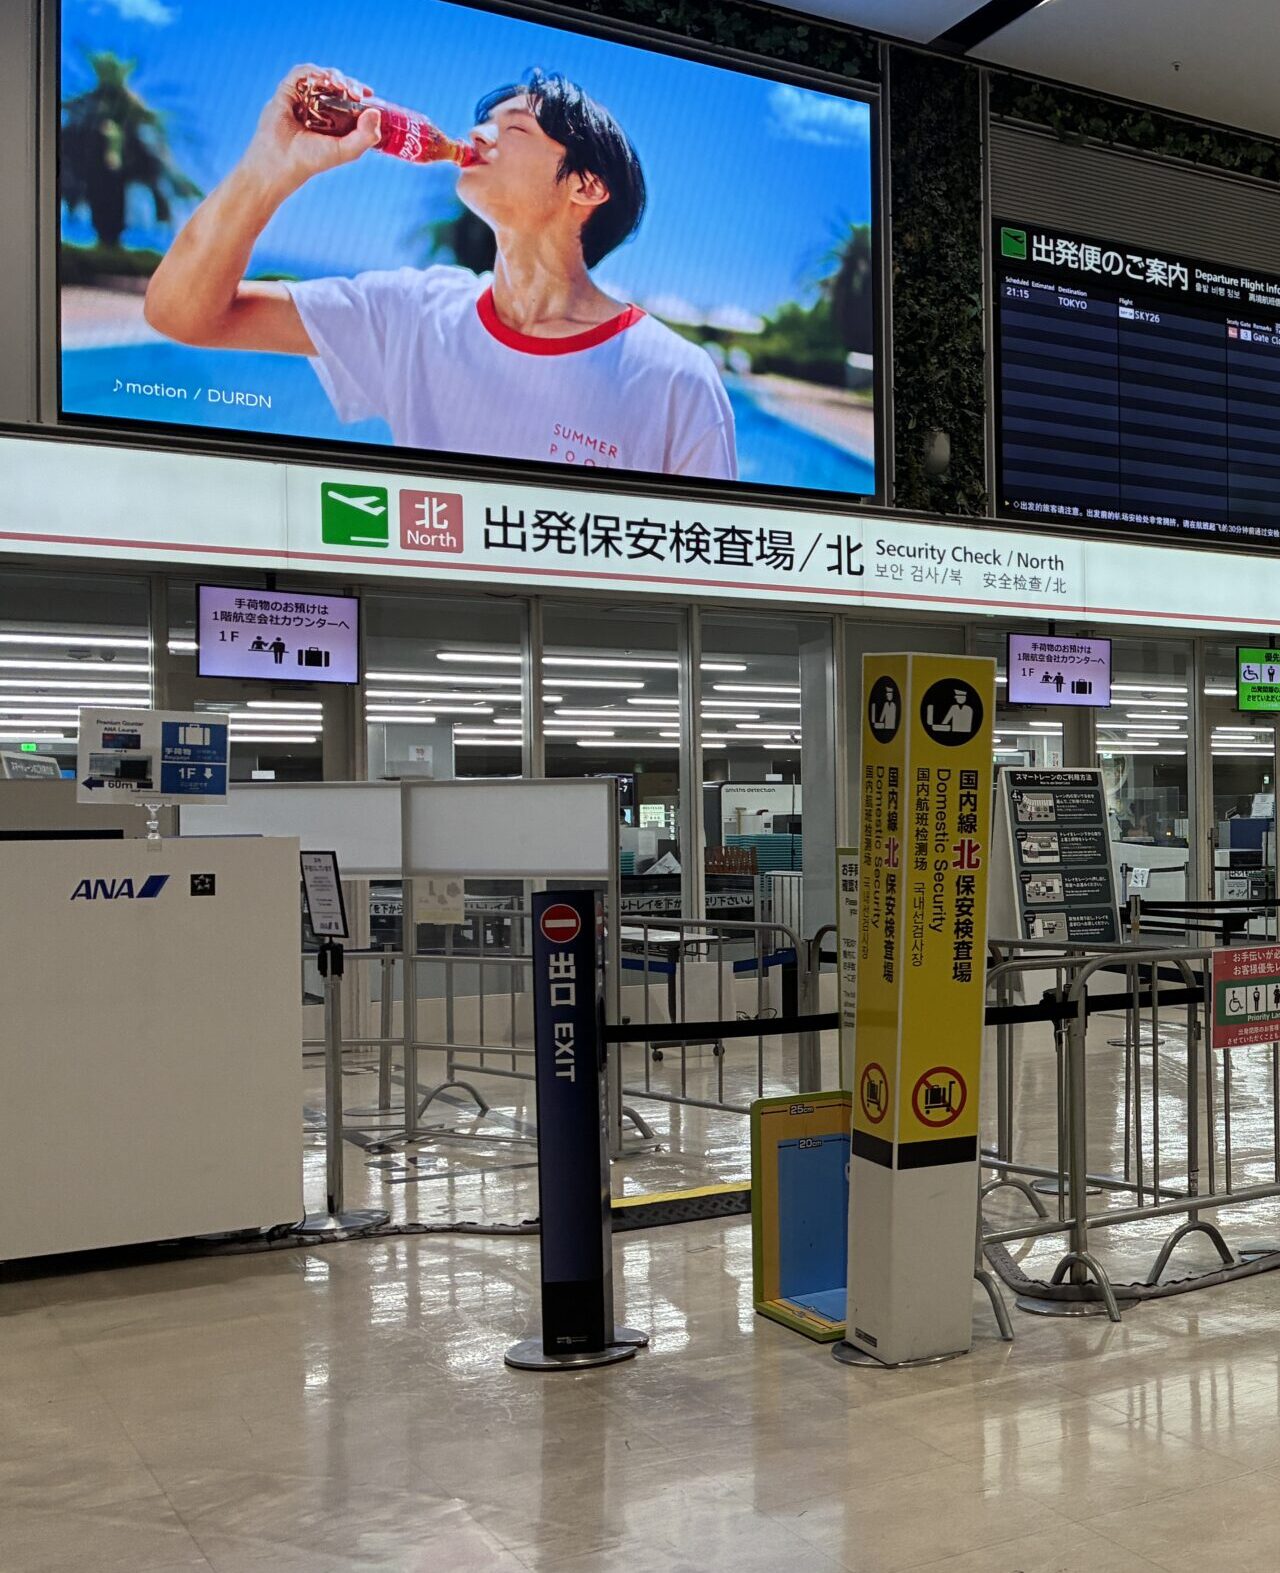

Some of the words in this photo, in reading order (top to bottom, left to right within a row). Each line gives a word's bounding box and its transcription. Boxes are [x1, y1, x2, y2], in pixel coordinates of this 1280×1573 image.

[1032, 234, 1189, 291] 出発便のご案内
[1005, 276, 1029, 287] Scheduled
[1031, 280, 1055, 291] Estimated
[1058, 285, 1088, 297] Destination
[1195, 269, 1239, 286] Departure
[1240, 278, 1264, 292] Flight
[1006, 287, 1030, 299] 21:15
[1058, 297, 1088, 310] TOKYO
[1119, 297, 1133, 306] Flight
[1134, 310, 1160, 323] SKY26
[1253, 333, 1269, 343] Gate
[126, 382, 188, 400] motion
[207, 388, 273, 409] DURDN
[553, 423, 618, 458] SUMMER
[414, 497, 449, 530] 北
[407, 529, 457, 548] North
[483, 504, 864, 577] 出発保安検査場/北
[875, 539, 947, 566] Security
[951, 546, 1002, 567] Check
[1017, 552, 1064, 572] North
[875, 564, 904, 581] 보안
[911, 565, 963, 586] 검사/북
[983, 572, 1067, 594] 安全检查/北
[234, 598, 329, 616] 手荷物のお預けは
[211, 610, 350, 630] 1階航空会社カウンターへ
[1017, 653, 1105, 665] 1階航空会社カウンターへ
[1031, 642, 1092, 654] 手荷物のお預けは
[107, 779, 133, 789] 60m
[178, 768, 197, 780] 1F
[1015, 772, 1093, 782] スマートレーンのご利用方法
[874, 766, 885, 850] Domestic
[913, 767, 930, 871] 国内航班检测场
[934, 768, 951, 853] Domestic
[952, 769, 981, 983] 国内線北保安検査場
[70, 878, 135, 901] ANA
[870, 855, 883, 928] Security
[928, 859, 949, 933] Security
[911, 882, 925, 967] 국내선검사장
[548, 952, 577, 1007] 出口
[1247, 1013, 1270, 1022] Priority
[554, 1022, 576, 1082] EXIT
[789, 1104, 814, 1115] 25cm
[799, 1138, 822, 1149] 20cm
